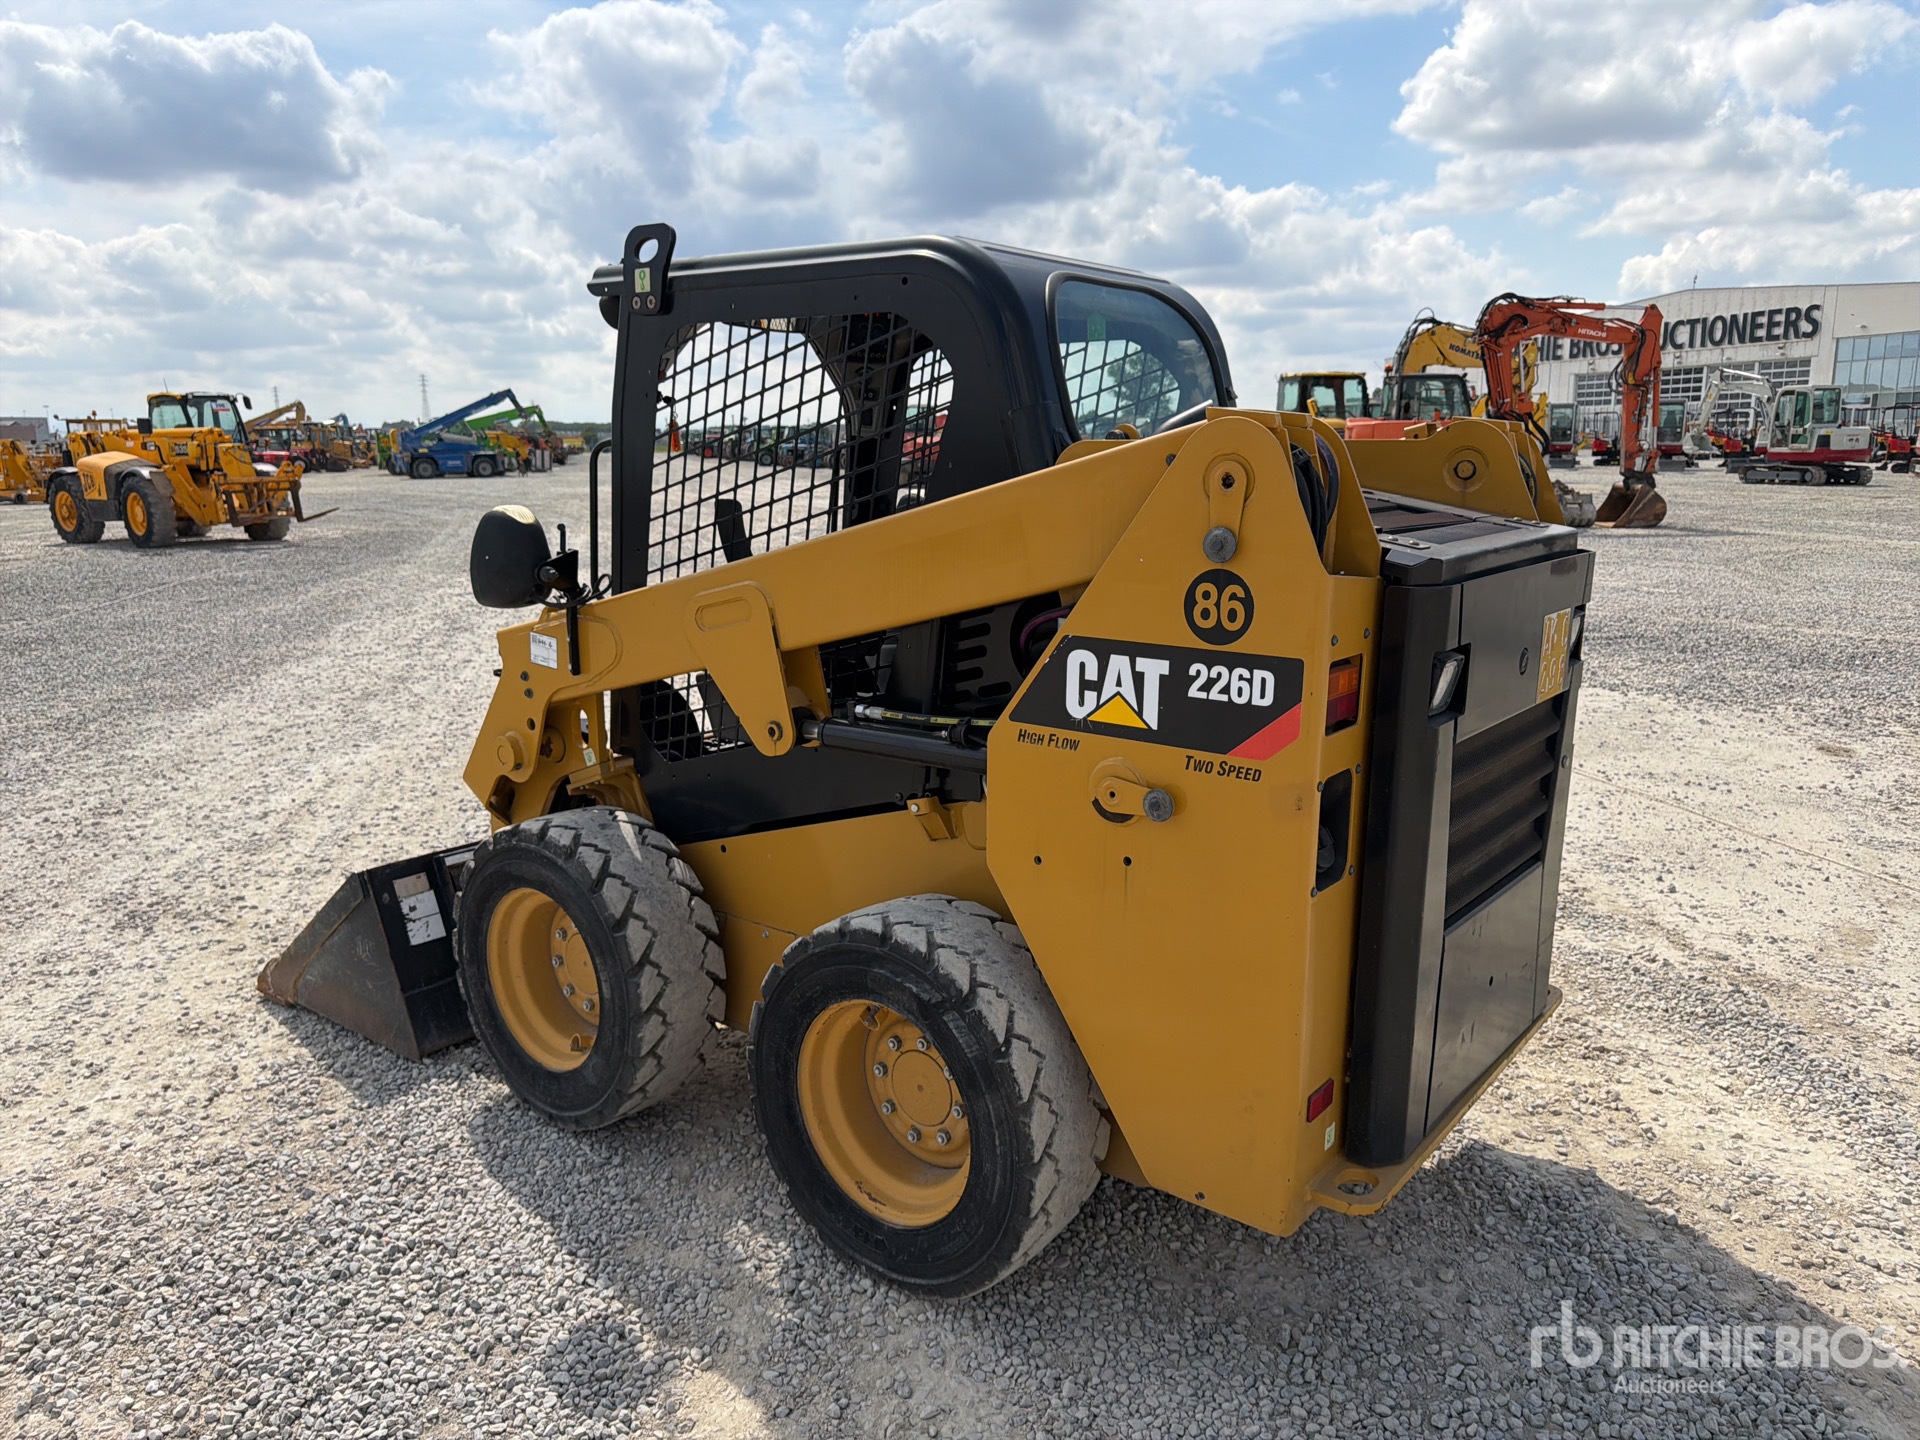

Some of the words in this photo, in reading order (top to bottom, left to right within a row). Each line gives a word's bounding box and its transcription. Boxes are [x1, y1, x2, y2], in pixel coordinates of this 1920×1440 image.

[1577, 328, 1607, 338] HITACHI
[1660, 304, 1822, 351] UCTIONEERS
[1192, 582, 1246, 632] 86
[1065, 649, 1170, 731] CAT
[1187, 662, 1275, 707] 226D
[1017, 728, 1045, 746] HIGH
[1047, 733, 1080, 752] FLOW
[1185, 755, 1214, 775] TWO
[1217, 760, 1262, 782] SPEED
